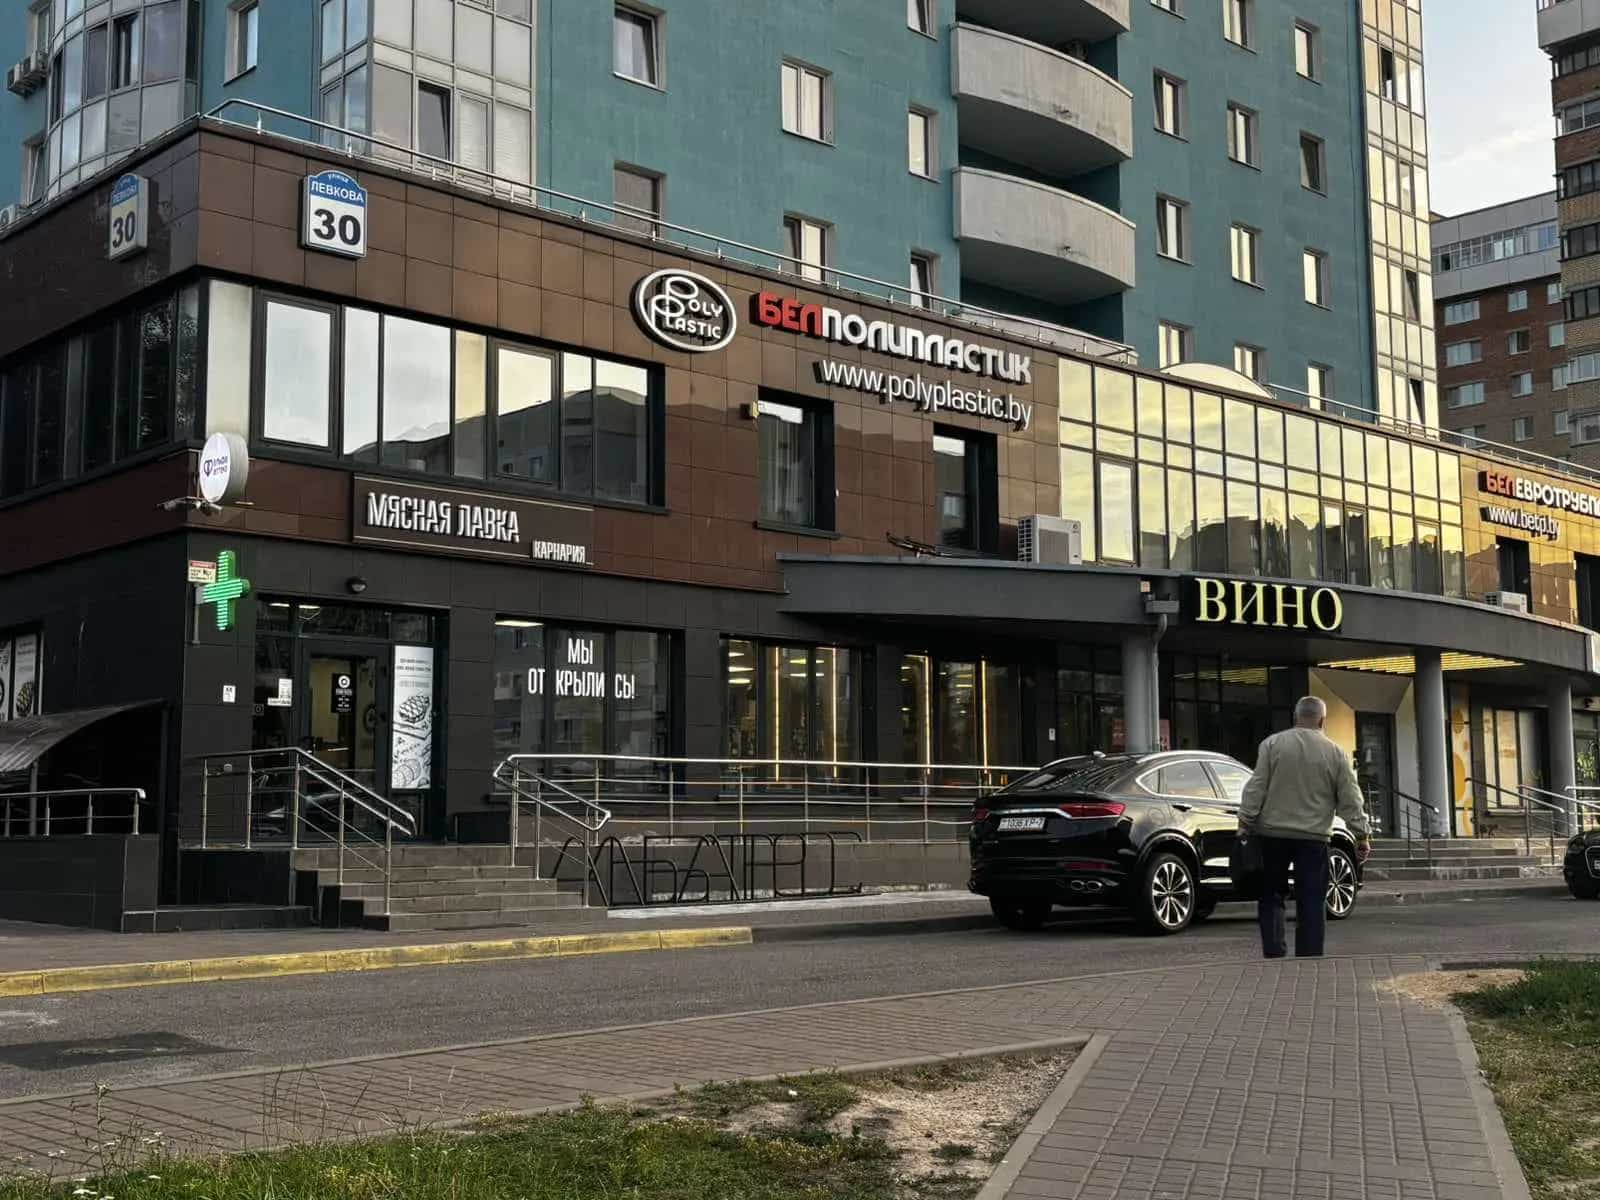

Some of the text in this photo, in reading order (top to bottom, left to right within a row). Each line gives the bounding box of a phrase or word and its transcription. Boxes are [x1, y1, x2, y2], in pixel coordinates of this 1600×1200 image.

[310, 180, 365, 203] ЛЕВКОВА
[112, 211, 136, 248] 30
[312, 208, 361, 246] 30
[757, 290, 1032, 385] БЕЛПОЛИПЛАСТИК
[821, 358, 1033, 428] www.polyplastic.by
[1487, 470, 1600, 517] БЕЛЕВРОТРУБП
[366, 491, 521, 544] МЯСНАЯ ЛАВКА
[1489, 506, 1560, 543] www.betp.by
[533, 539, 587, 564] КАРНАРИЯ
[1194, 577, 1343, 632] ВИНО
[567, 637, 594, 665] МЫ
